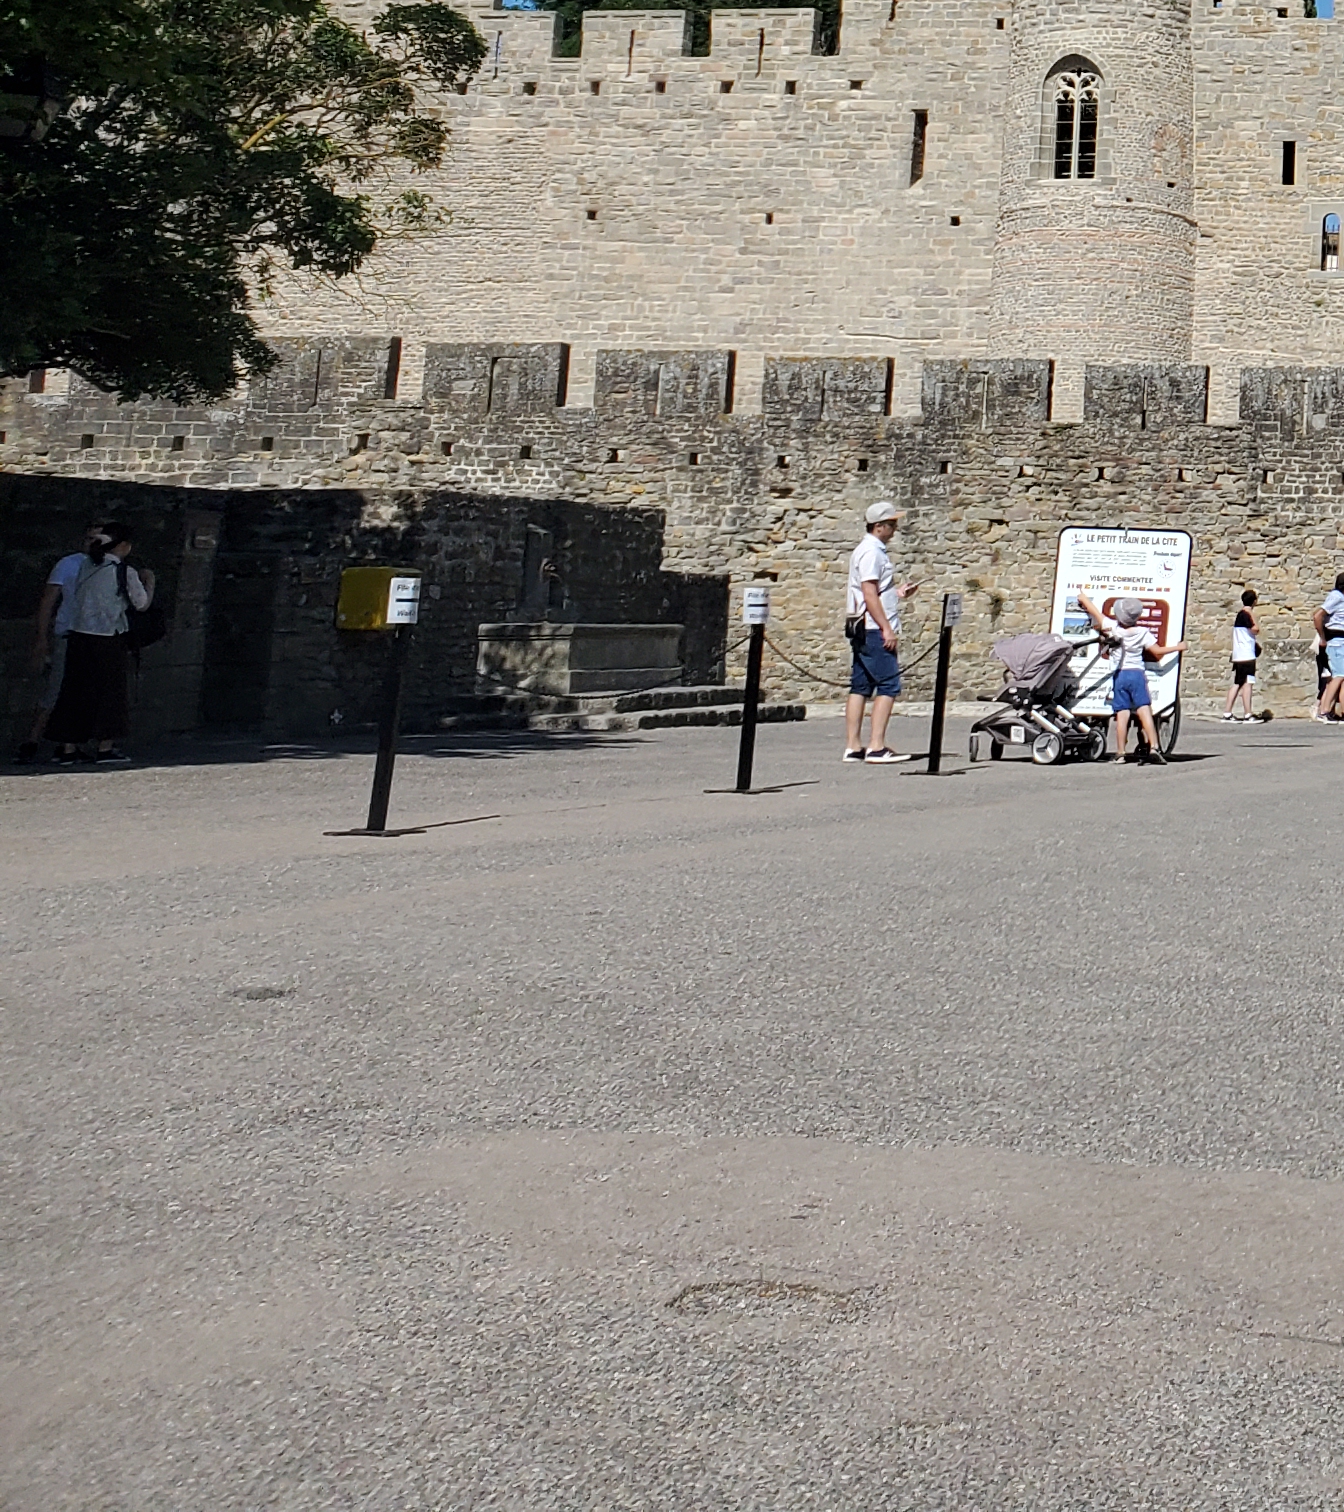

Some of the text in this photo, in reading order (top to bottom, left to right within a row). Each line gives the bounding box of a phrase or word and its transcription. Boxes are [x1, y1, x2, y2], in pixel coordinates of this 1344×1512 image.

[1087, 534, 1095, 542] LE
[1097, 535, 1117, 544] PETIT
[1119, 535, 1139, 545] TRAIN
[1141, 536, 1150, 545] DE
[1151, 537, 1160, 545] LA
